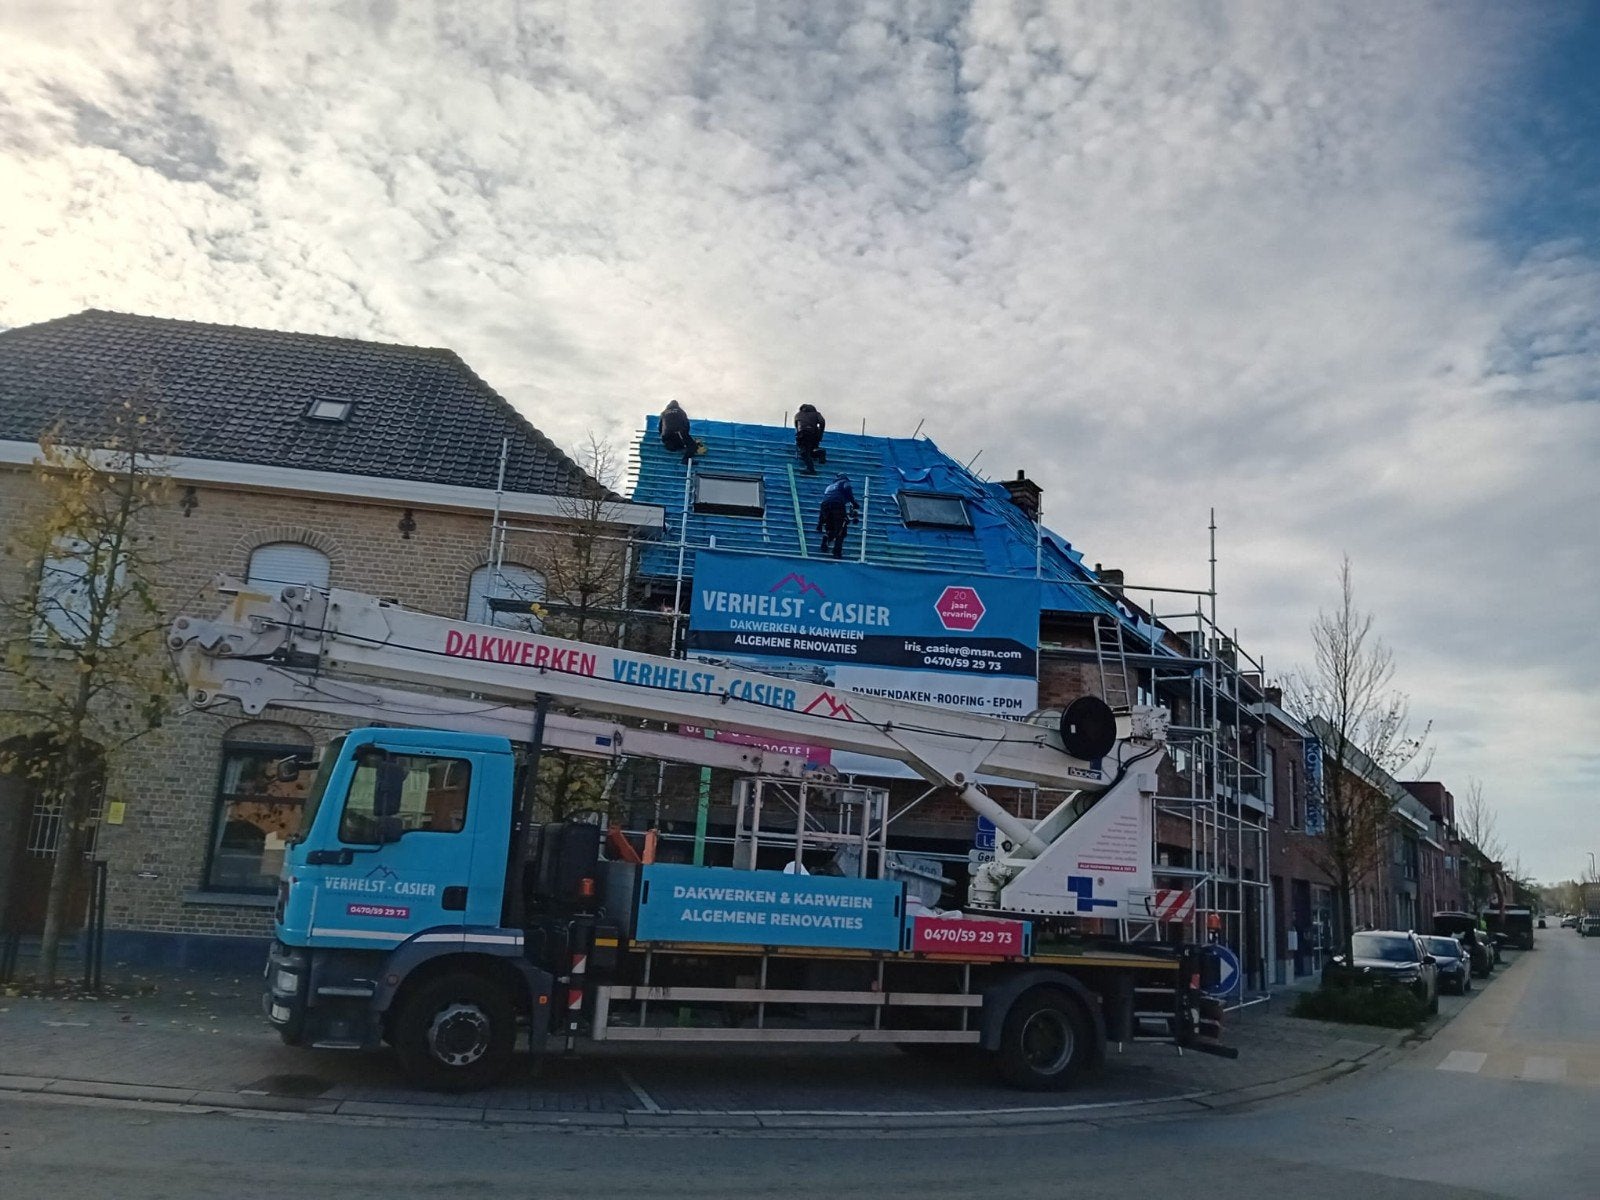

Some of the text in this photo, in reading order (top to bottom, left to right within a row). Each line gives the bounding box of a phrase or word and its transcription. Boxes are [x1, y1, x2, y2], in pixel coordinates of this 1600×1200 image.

[702, 589, 805, 618] VERHELST
[819, 601, 890, 627] CASIER
[951, 601, 968, 610] jaar
[942, 610, 978, 620] ervaring
[730, 618, 864, 640] DAKWERKEN & KARWEIEN
[734, 634, 858, 655] ALGEMENE RENOVATIES
[904, 641, 1022, 659] iris_casier@msn.com
[445, 630, 597, 677] DAKWERKEN
[612, 658, 715, 695] VERHELST
[729, 679, 797, 710] CASIER
[924, 656, 1002, 670] 0470/59 29 73
[993, 697, 1022, 709] EPDM
[983, 835, 996, 847] La
[977, 851, 996, 862] Gen
[325, 876, 386, 892] VERHELST
[394, 882, 436, 896] CASIER
[673, 886, 873, 909] DAKWERKEN & KARWEIEN
[384, 908, 395, 916] 29
[396, 909, 407, 917] 73
[680, 909, 863, 930] ALGEMENE RENOVATIES
[924, 928, 1013, 944] 0470/59 29 73
